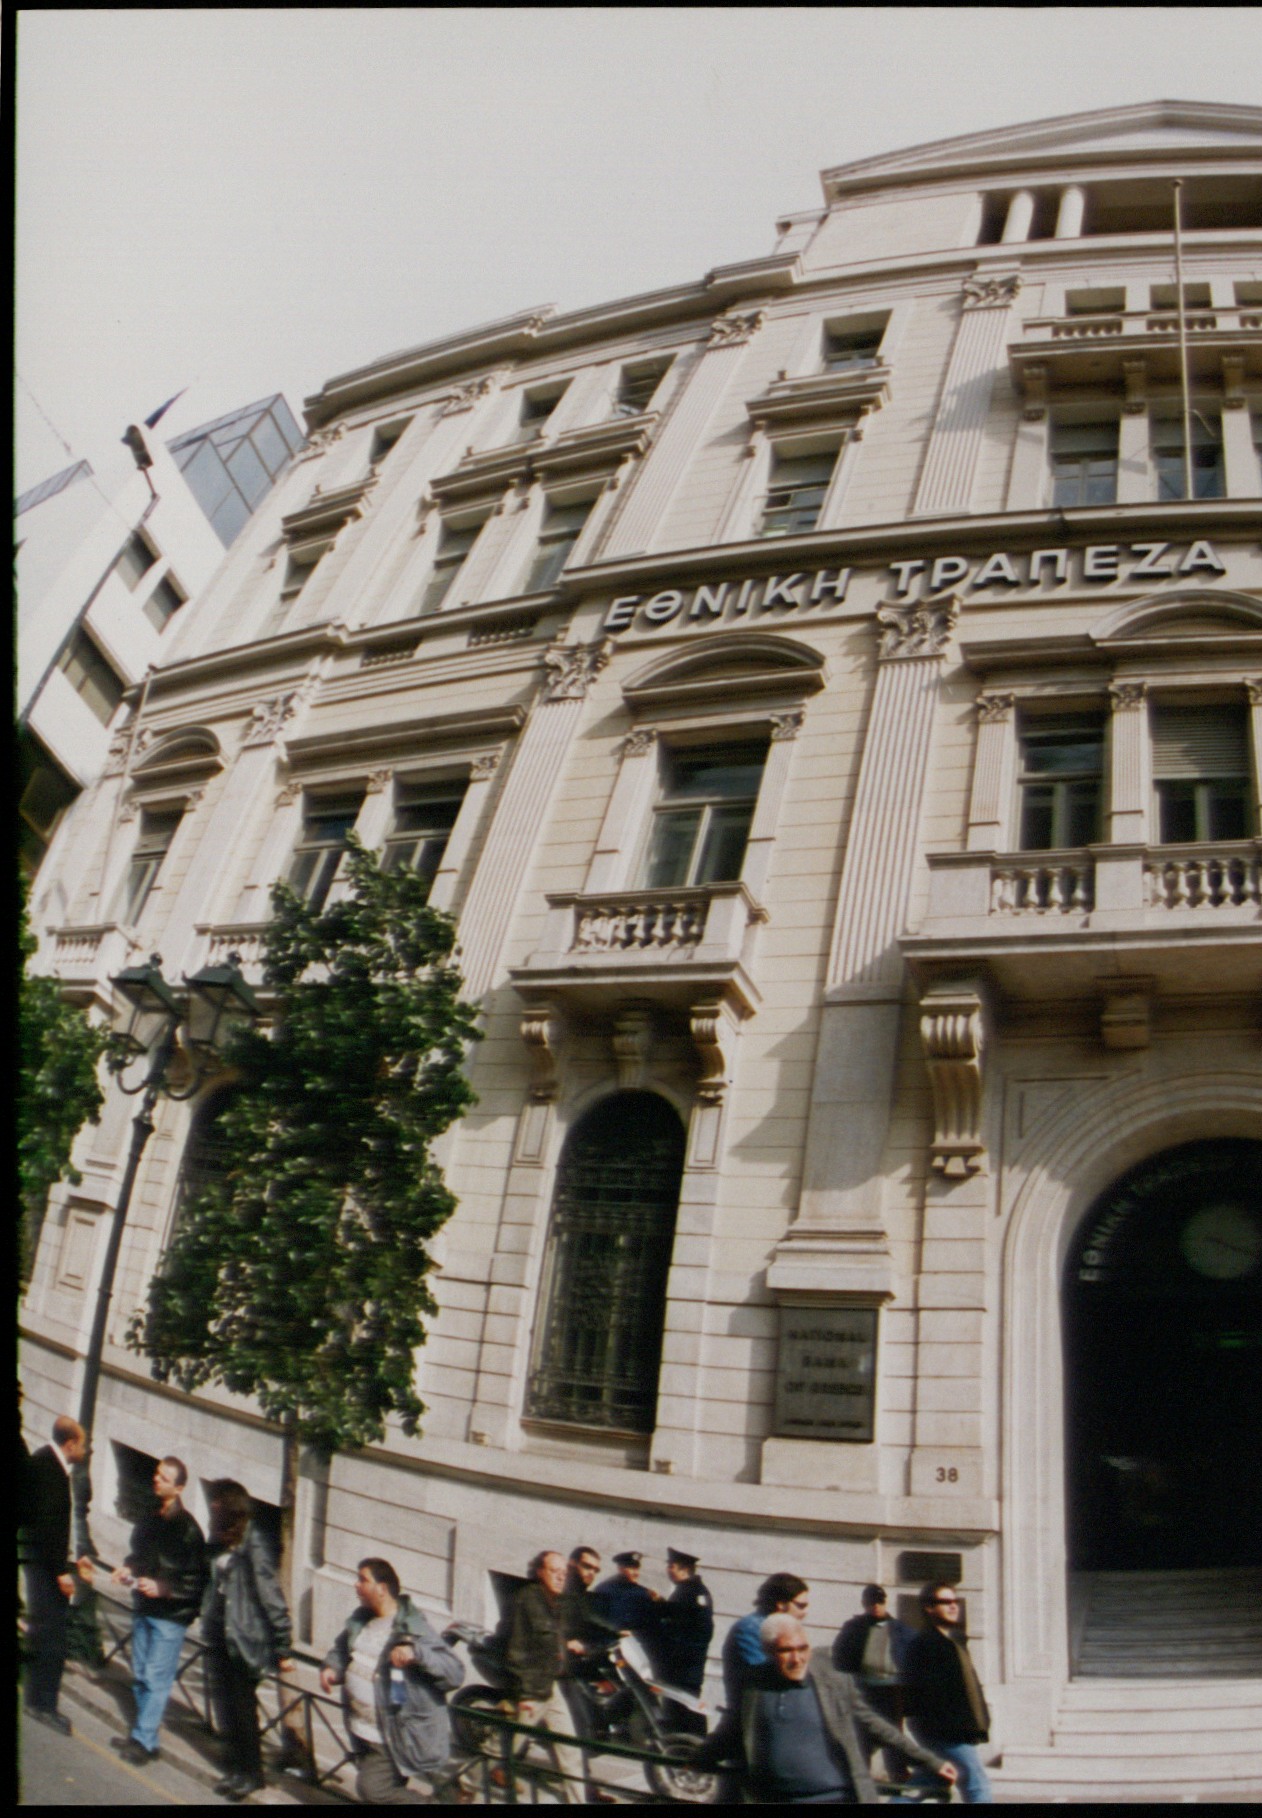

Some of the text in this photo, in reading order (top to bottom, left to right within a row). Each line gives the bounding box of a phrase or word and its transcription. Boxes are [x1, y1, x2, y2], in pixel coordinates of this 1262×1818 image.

[602, 566, 851, 632] ΕΘΝΙΚΗ
[889, 541, 1226, 595] ΤΡΑΠΕΖΑ
[935, 1466, 959, 1483] 38
